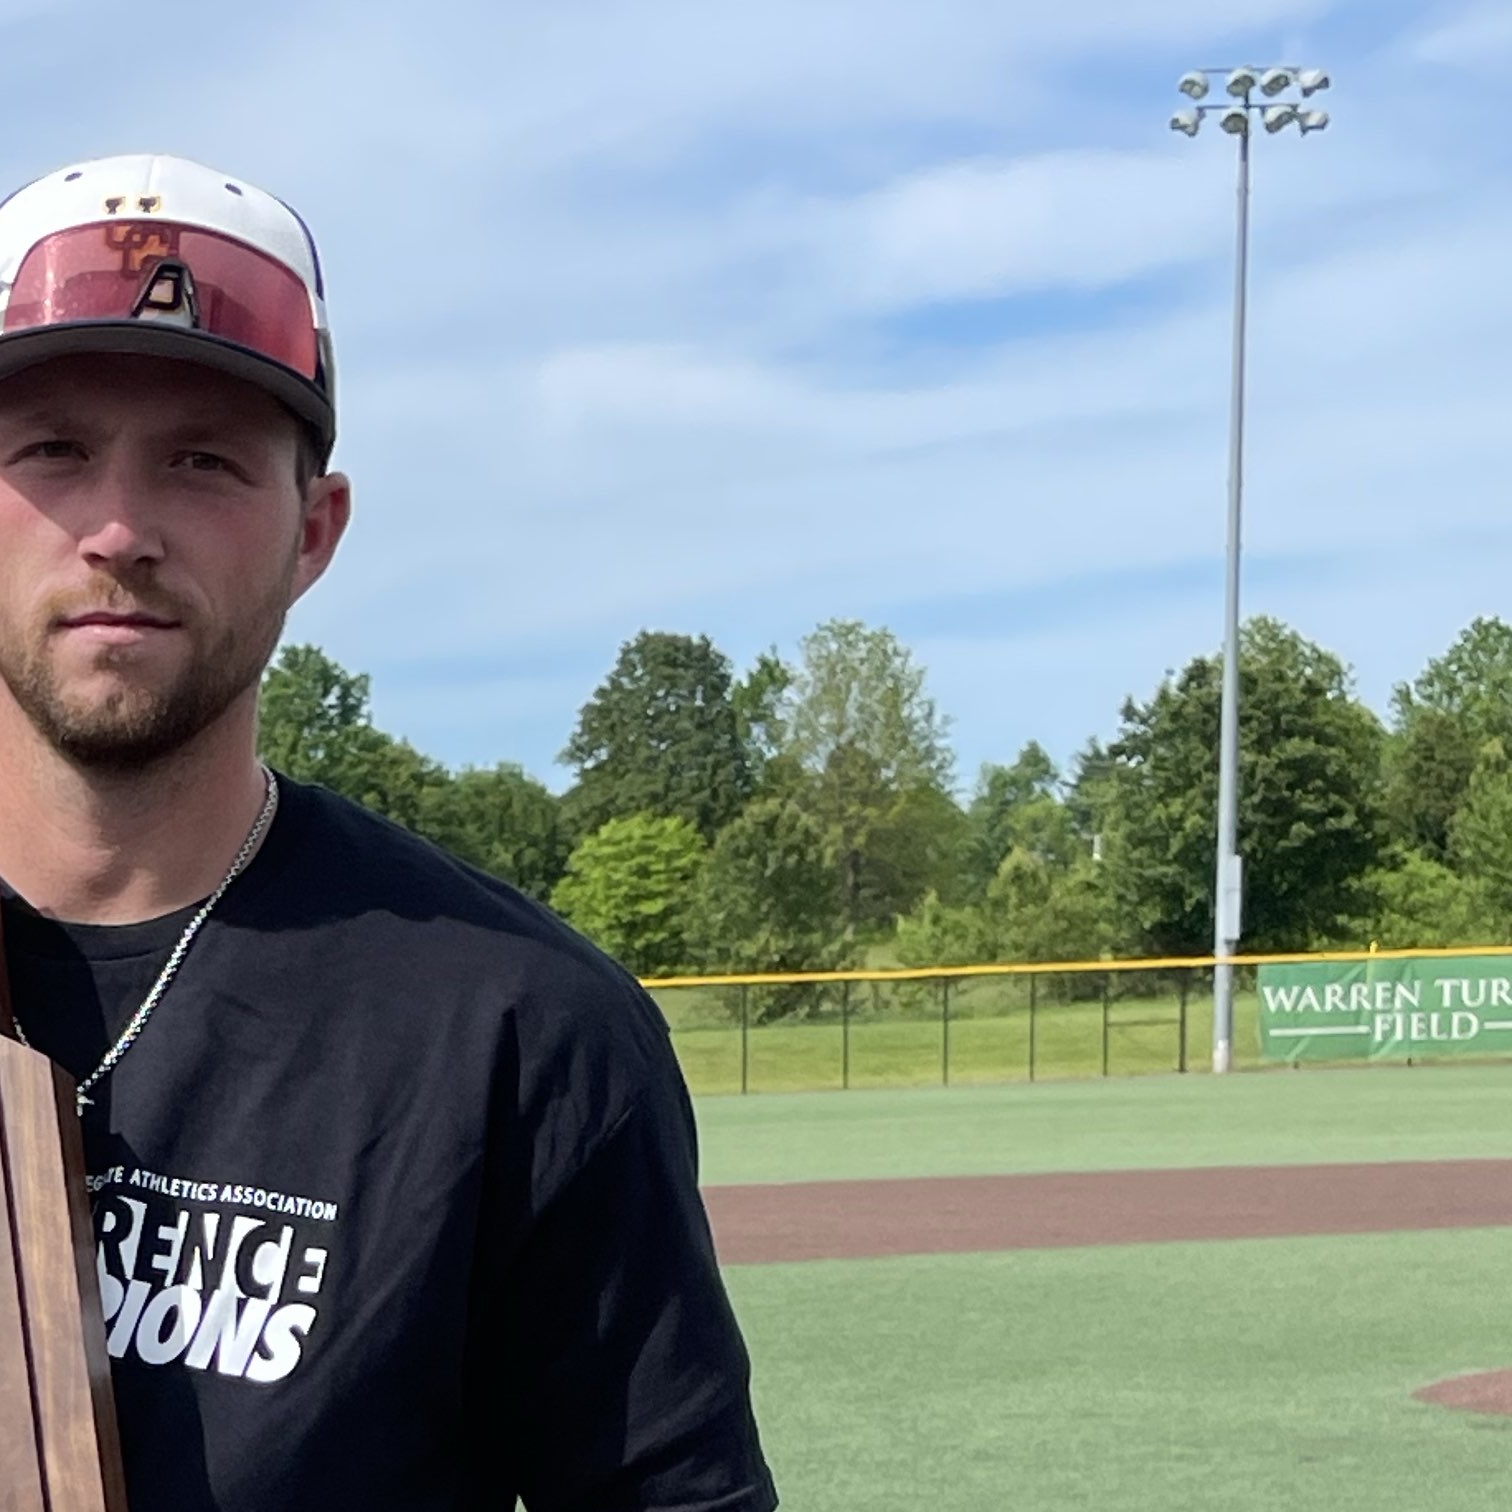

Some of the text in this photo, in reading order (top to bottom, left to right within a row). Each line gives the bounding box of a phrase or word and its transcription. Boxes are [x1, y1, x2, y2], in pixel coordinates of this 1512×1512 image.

[1262, 979, 1422, 1014] WARREN
[1373, 1010, 1480, 1042] FIELD
[129, 1168, 218, 1202] ATHLETICS
[220, 1184, 338, 1221] ASSOCIATION
